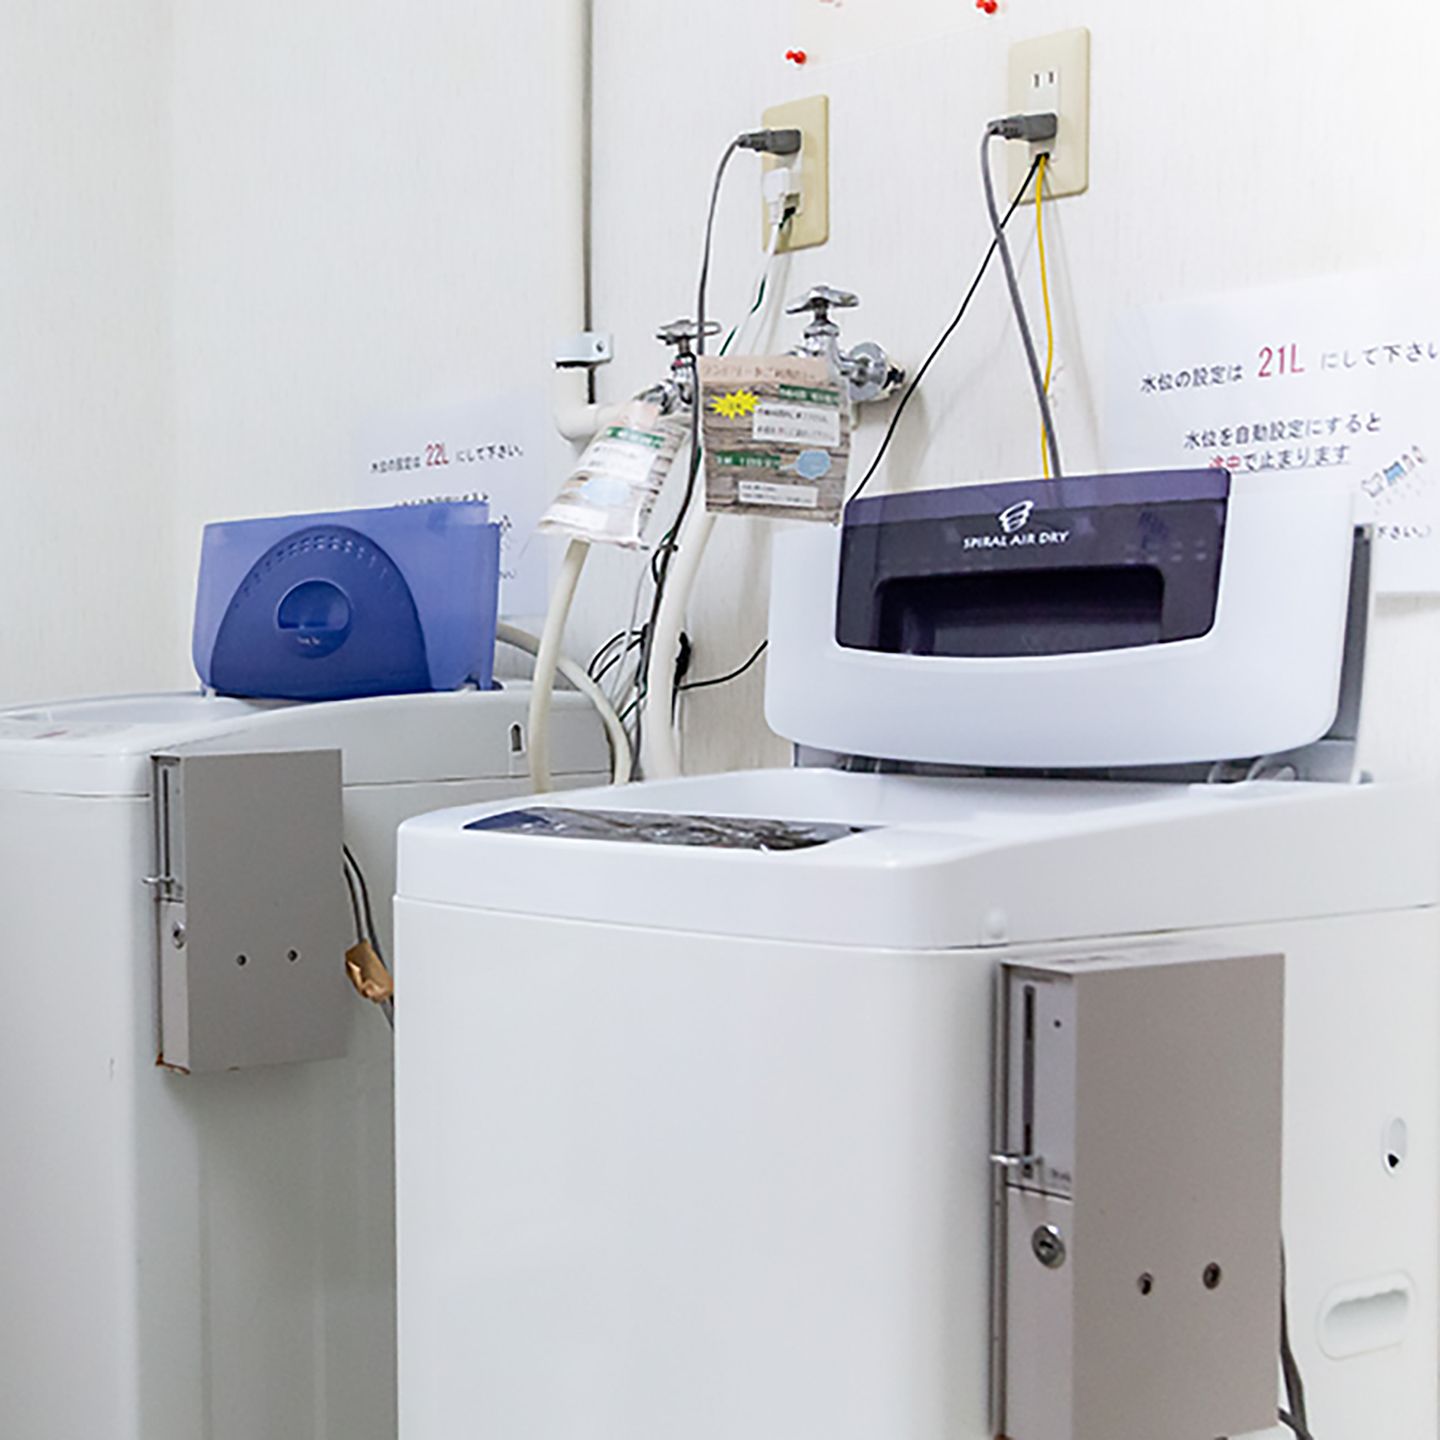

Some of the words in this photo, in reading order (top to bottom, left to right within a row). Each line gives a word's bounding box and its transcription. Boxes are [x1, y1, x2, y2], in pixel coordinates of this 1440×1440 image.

[1140, 364, 1244, 393] 水位の設定は
[1257, 343, 1305, 378] 21L
[1184, 412, 1382, 449] 水位を自動設定にすると
[963, 535, 1007, 550] SPIRAL
[1010, 533, 1035, 547] AIR
[1039, 531, 1069, 545] DRY
